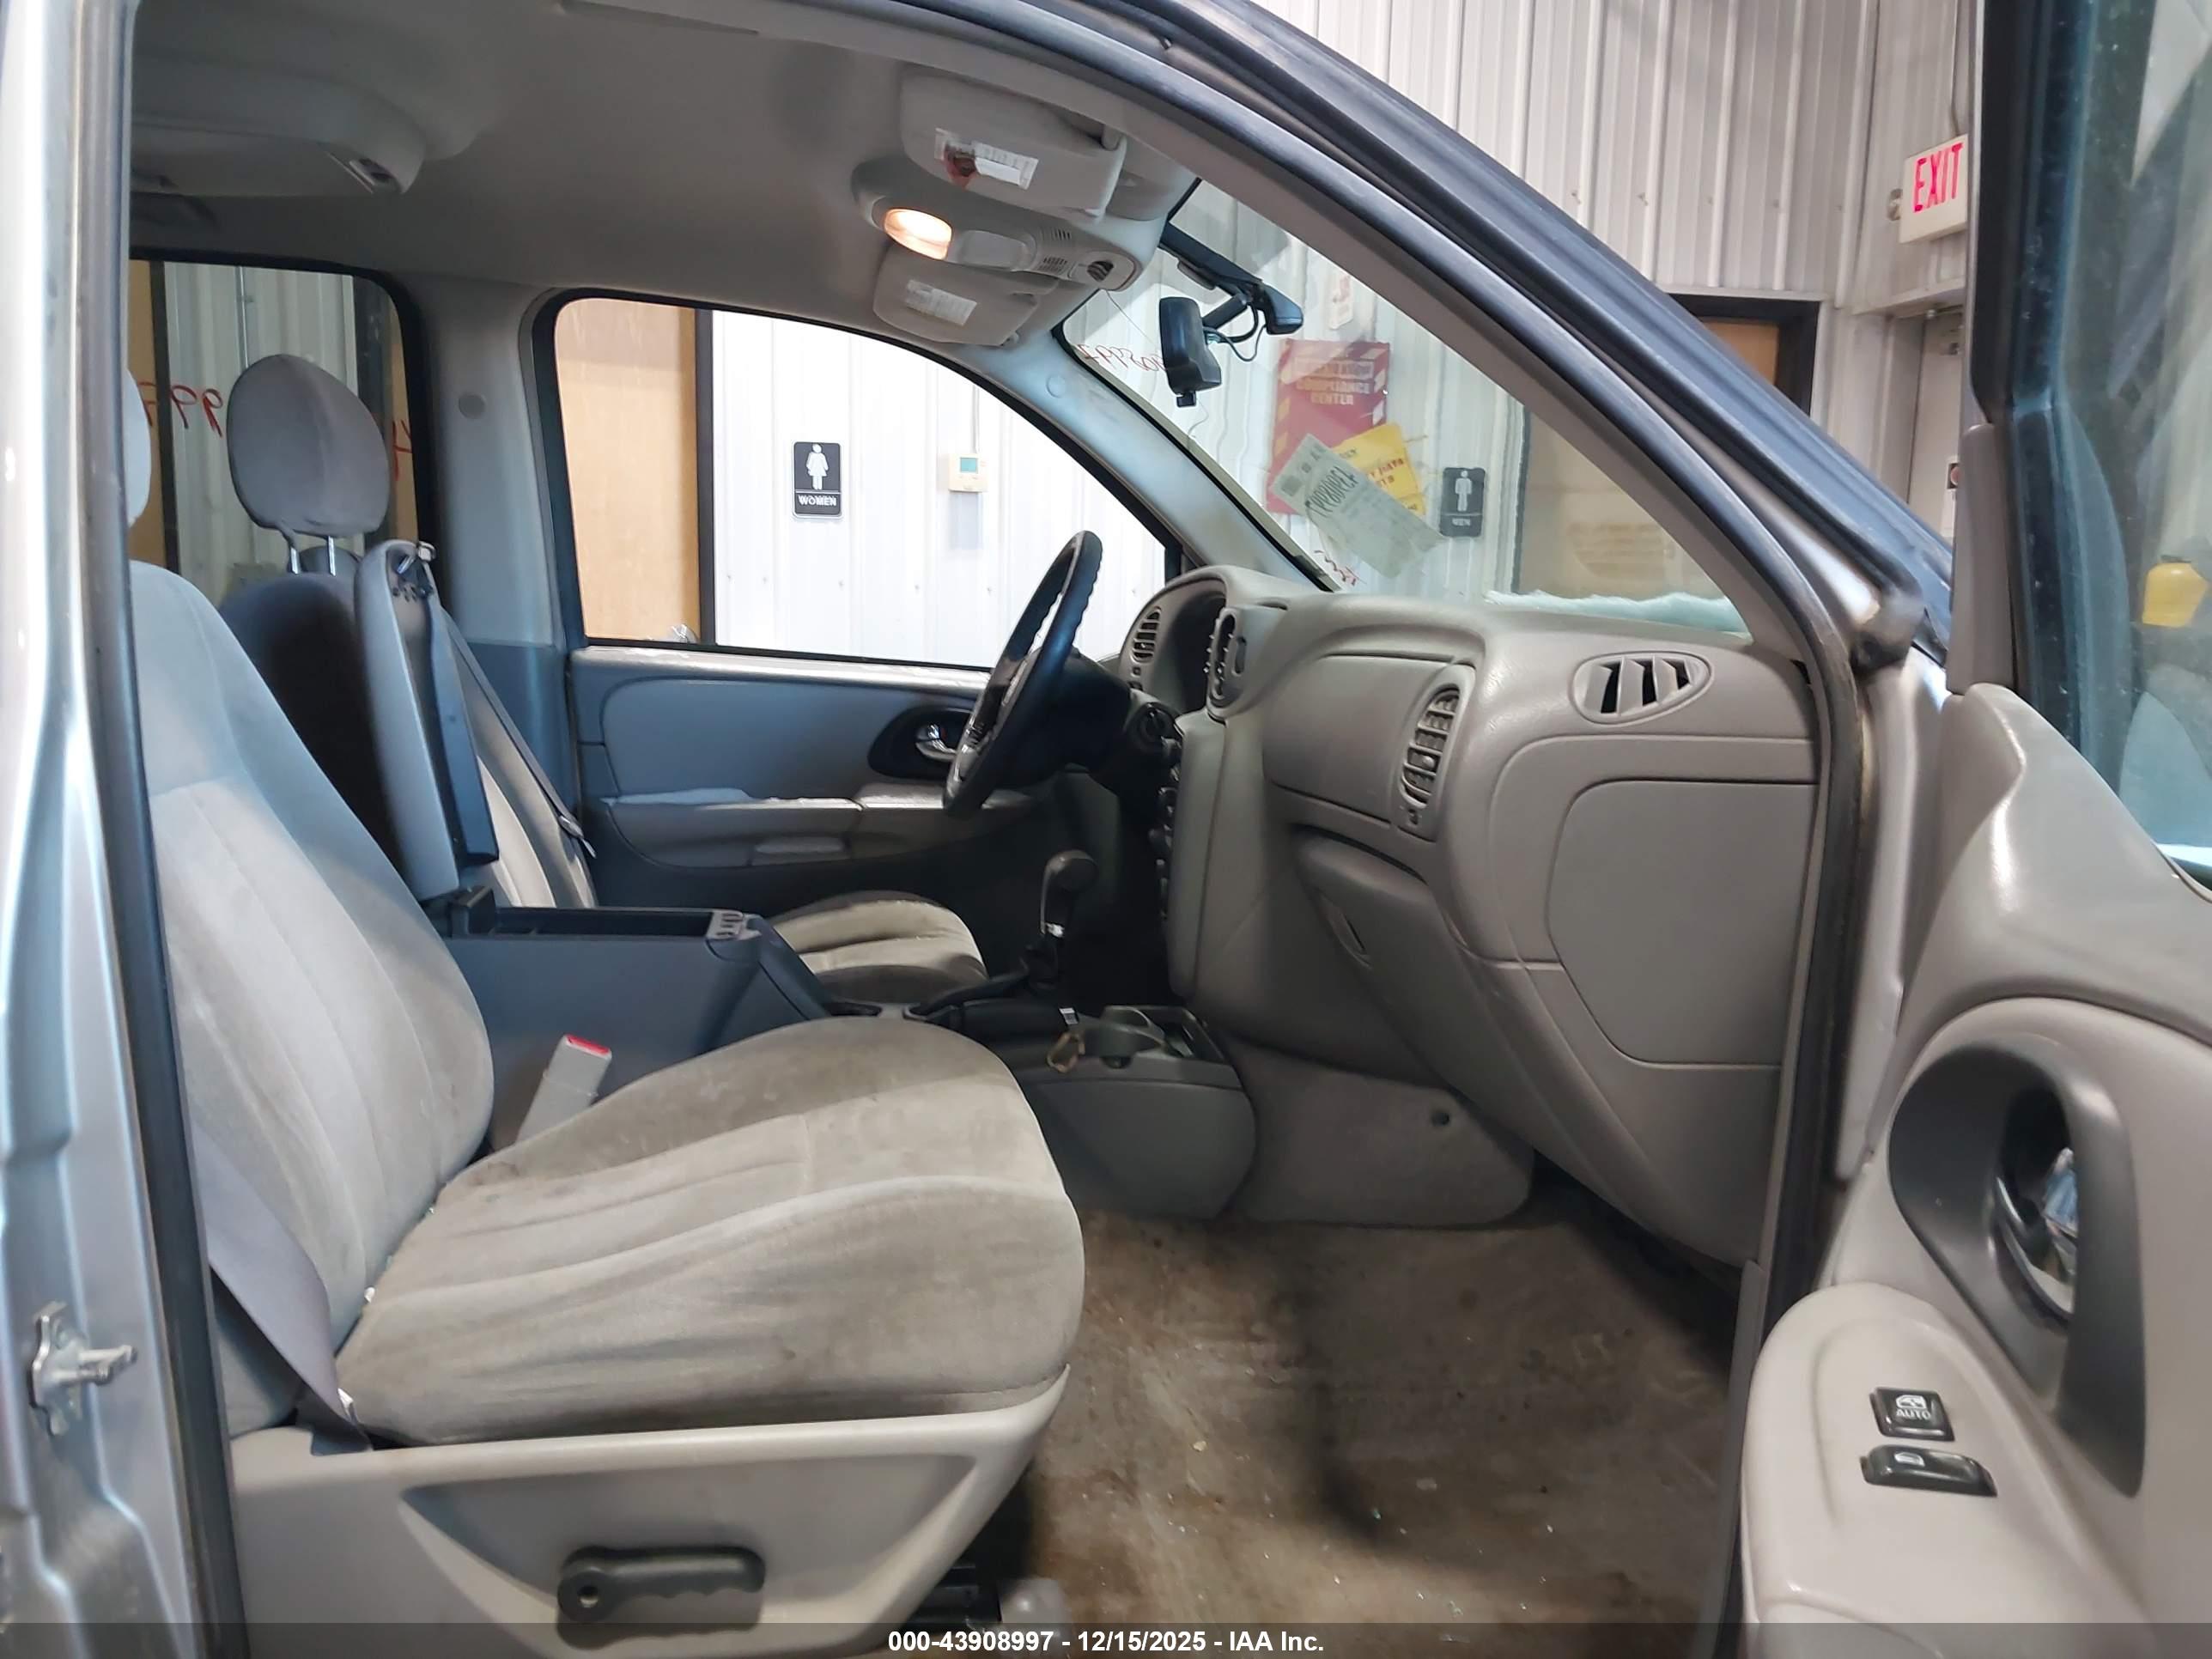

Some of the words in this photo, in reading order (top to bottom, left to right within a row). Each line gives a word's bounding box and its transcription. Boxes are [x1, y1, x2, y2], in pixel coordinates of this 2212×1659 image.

[1912, 141, 1964, 213] EXIT
[1310, 392, 1354, 406] CENTER
[798, 494, 837, 507] WOMEN
[1895, 1408, 1932, 1420] AUTO
